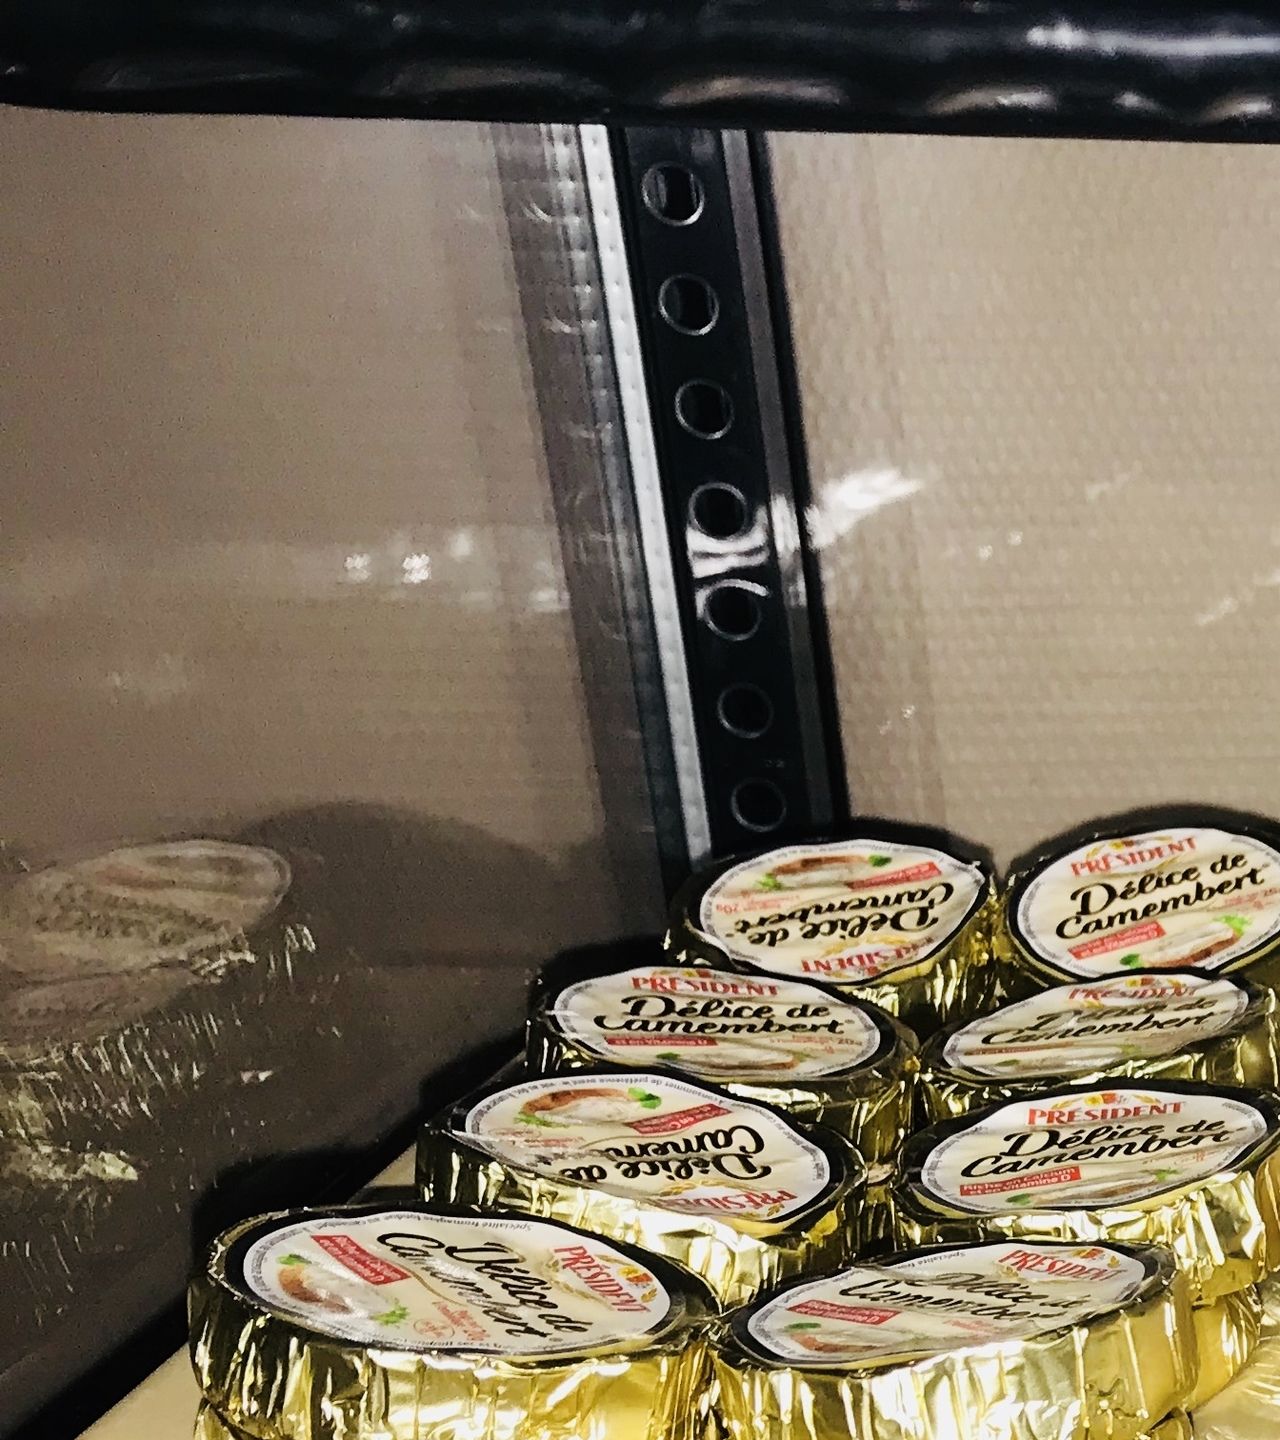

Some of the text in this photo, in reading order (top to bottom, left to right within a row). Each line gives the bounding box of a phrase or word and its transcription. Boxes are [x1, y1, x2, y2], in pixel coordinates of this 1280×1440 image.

[1055, 867, 1266, 940] Camembert
[1069, 853, 1248, 917] Délice de
[735, 882, 955, 934] Camembert
[748, 907, 940, 948] Délice de
[593, 1015, 846, 1035] Camembert
[620, 995, 830, 1019] Délice de
[1028, 1100, 1185, 1126] PRÉSIDENT
[960, 1128, 1234, 1178] Camembert
[994, 1119, 1226, 1158] Délice de
[613, 1152, 773, 1182] Délice
[553, 1244, 651, 1314] PRÉSIDENT
[997, 1249, 1130, 1282] PRÉSIDENT
[445, 1241, 559, 1311] Délice
[537, 1312, 594, 1338] de
